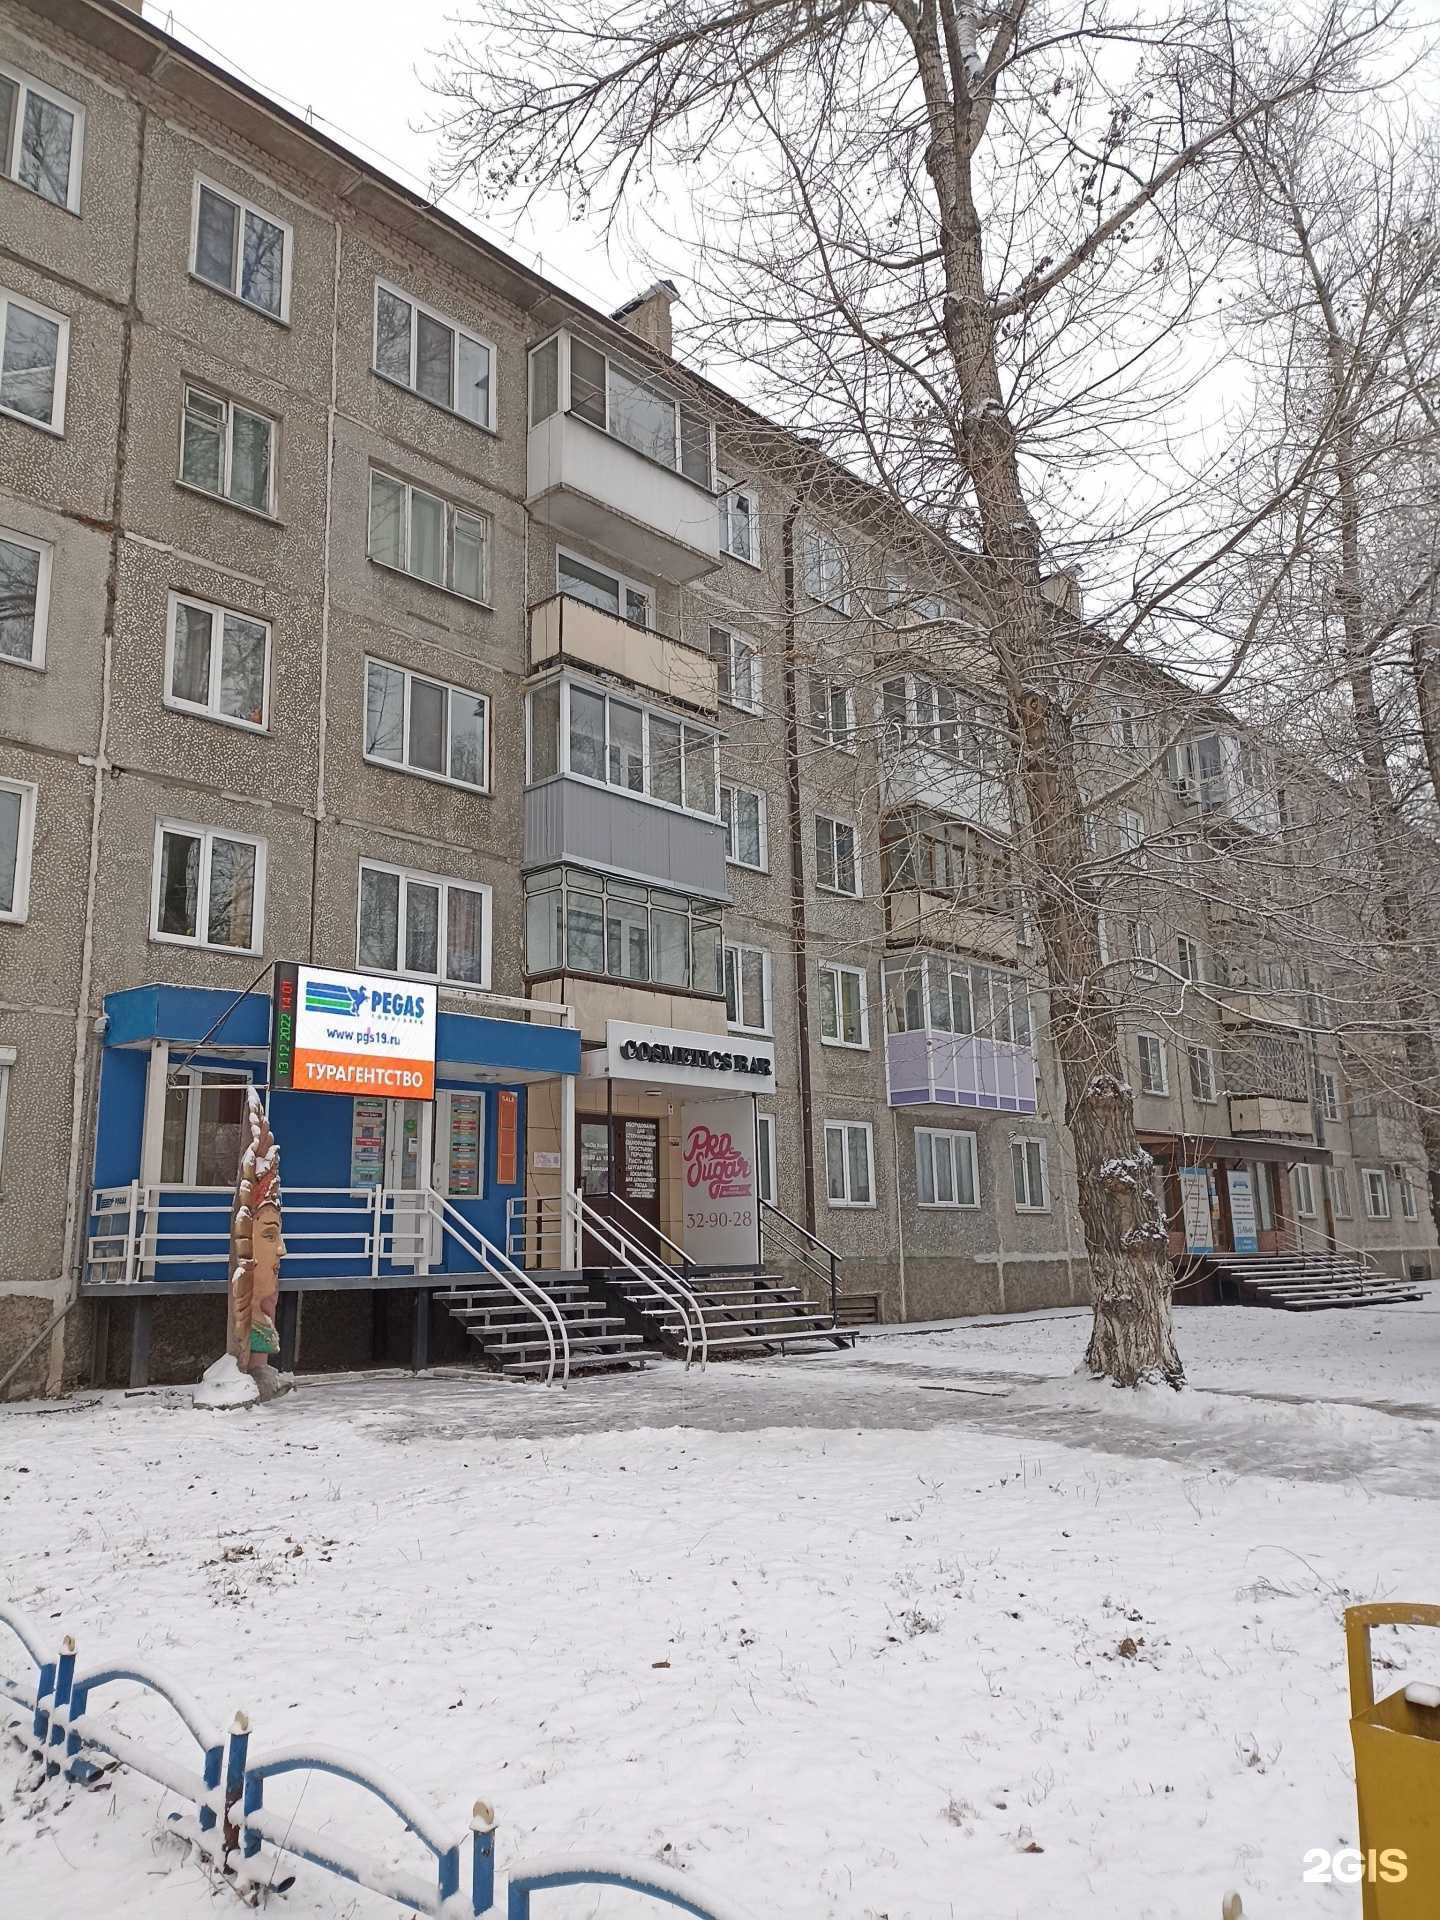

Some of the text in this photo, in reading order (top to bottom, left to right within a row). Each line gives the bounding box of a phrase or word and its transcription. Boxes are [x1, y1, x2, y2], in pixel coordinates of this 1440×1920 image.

[371, 990, 425, 1019] PEGAS
[619, 1039, 773, 1076] COSMETICS BAR
[305, 1062, 424, 1088] ТУРАГЕНТСТВО
[687, 1151, 752, 1200] Sugar
[686, 1210, 752, 1229] 32-90-28
